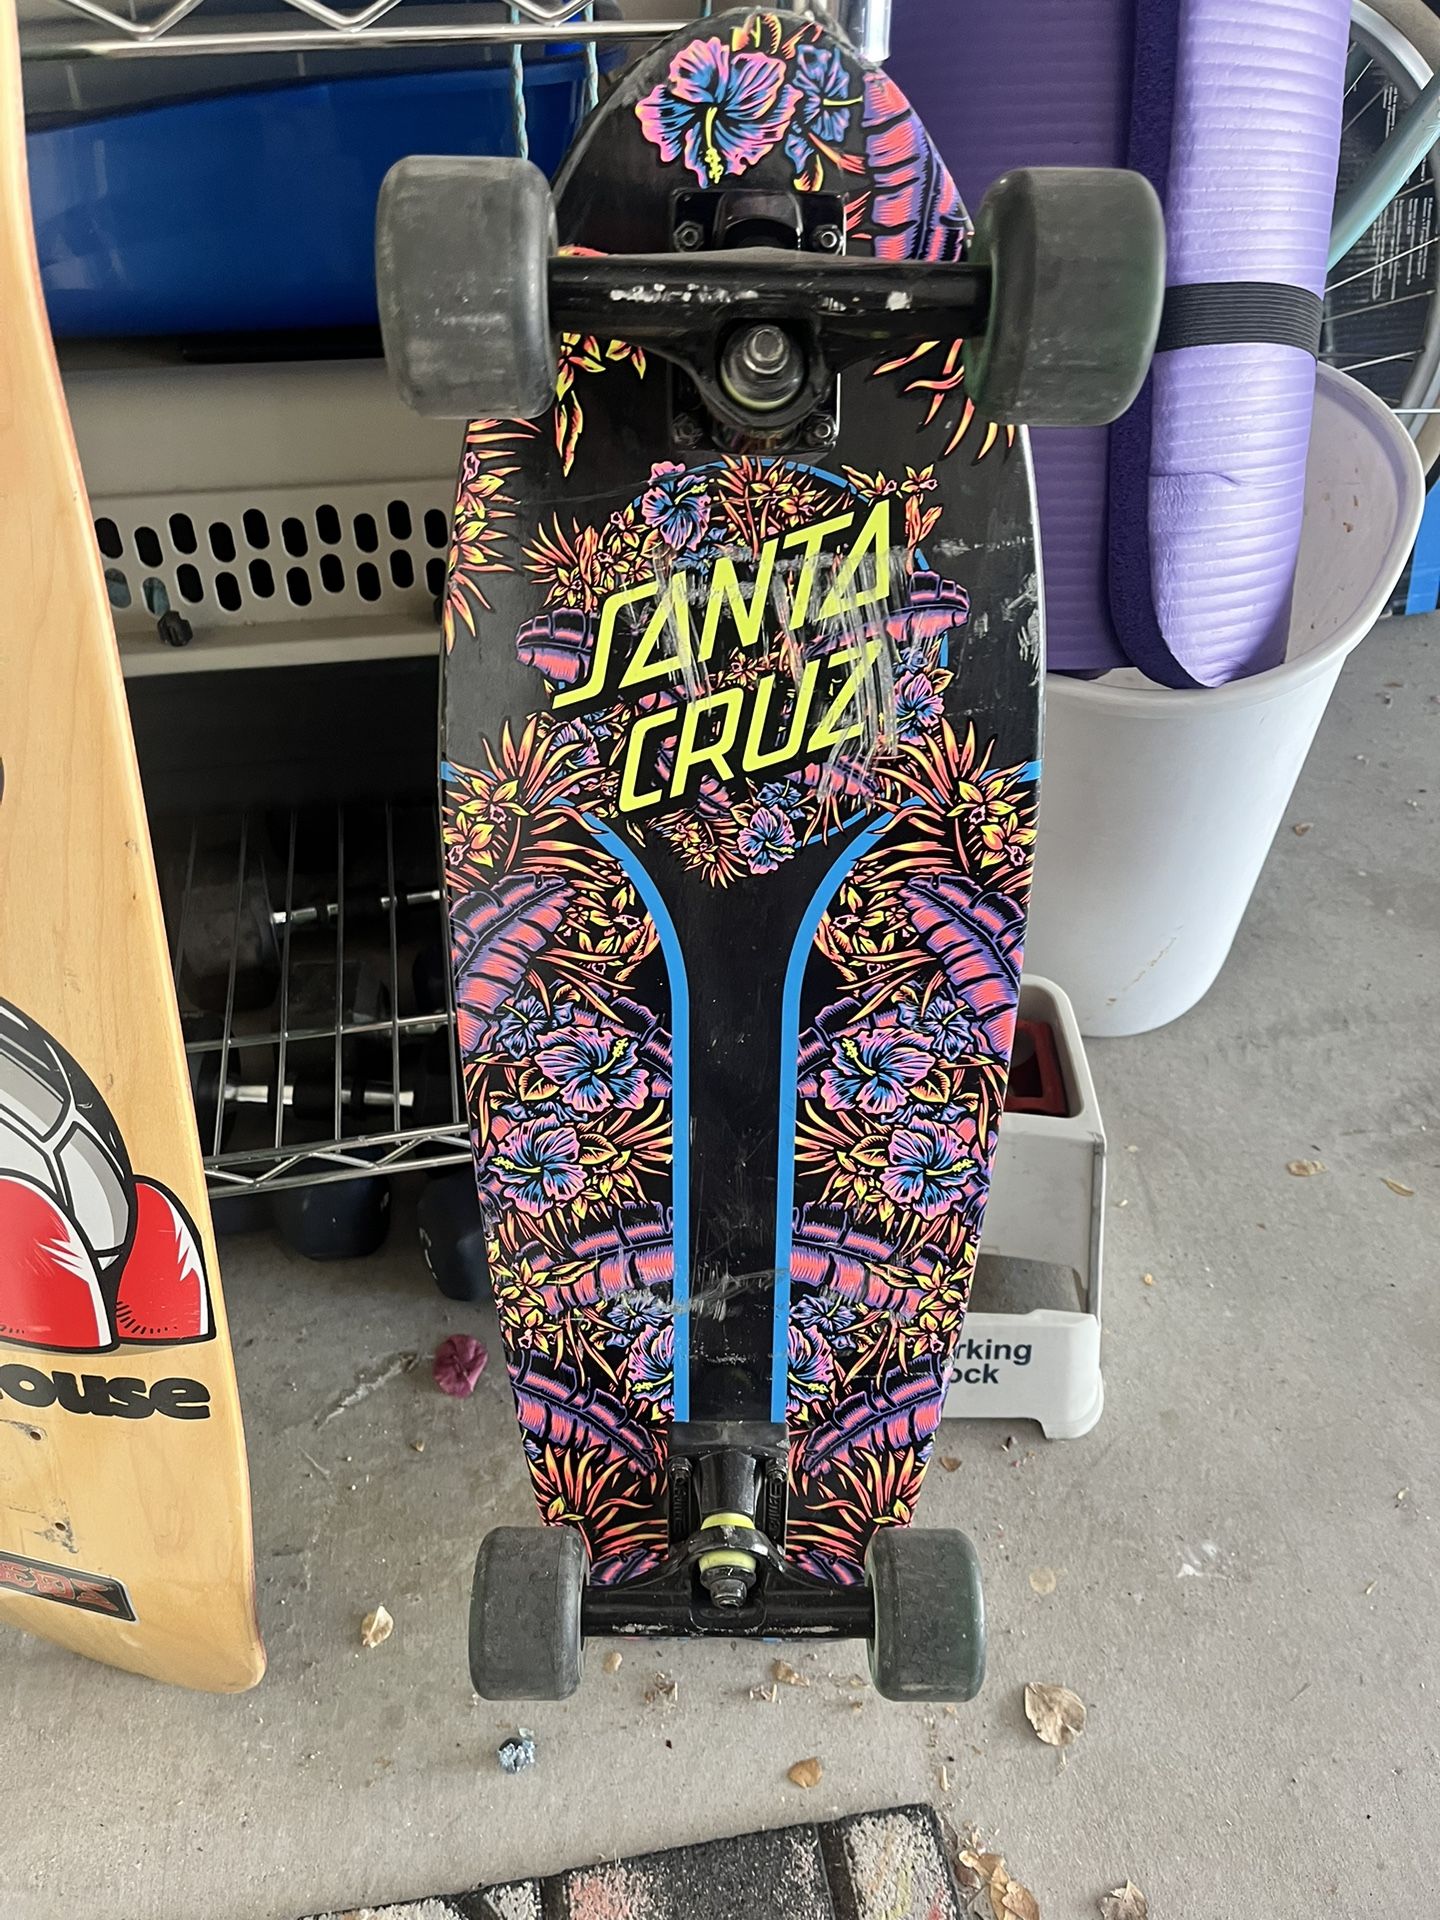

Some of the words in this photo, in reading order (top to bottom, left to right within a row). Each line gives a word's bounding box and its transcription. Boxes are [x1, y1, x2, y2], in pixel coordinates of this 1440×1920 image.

[552, 500, 890, 709] SANTA
[619, 638, 882, 813] CRUZ
[950, 1363, 1000, 1384] ock
[955, 1338, 1032, 1366] rking
[0, 1364, 211, 1419] ouse
